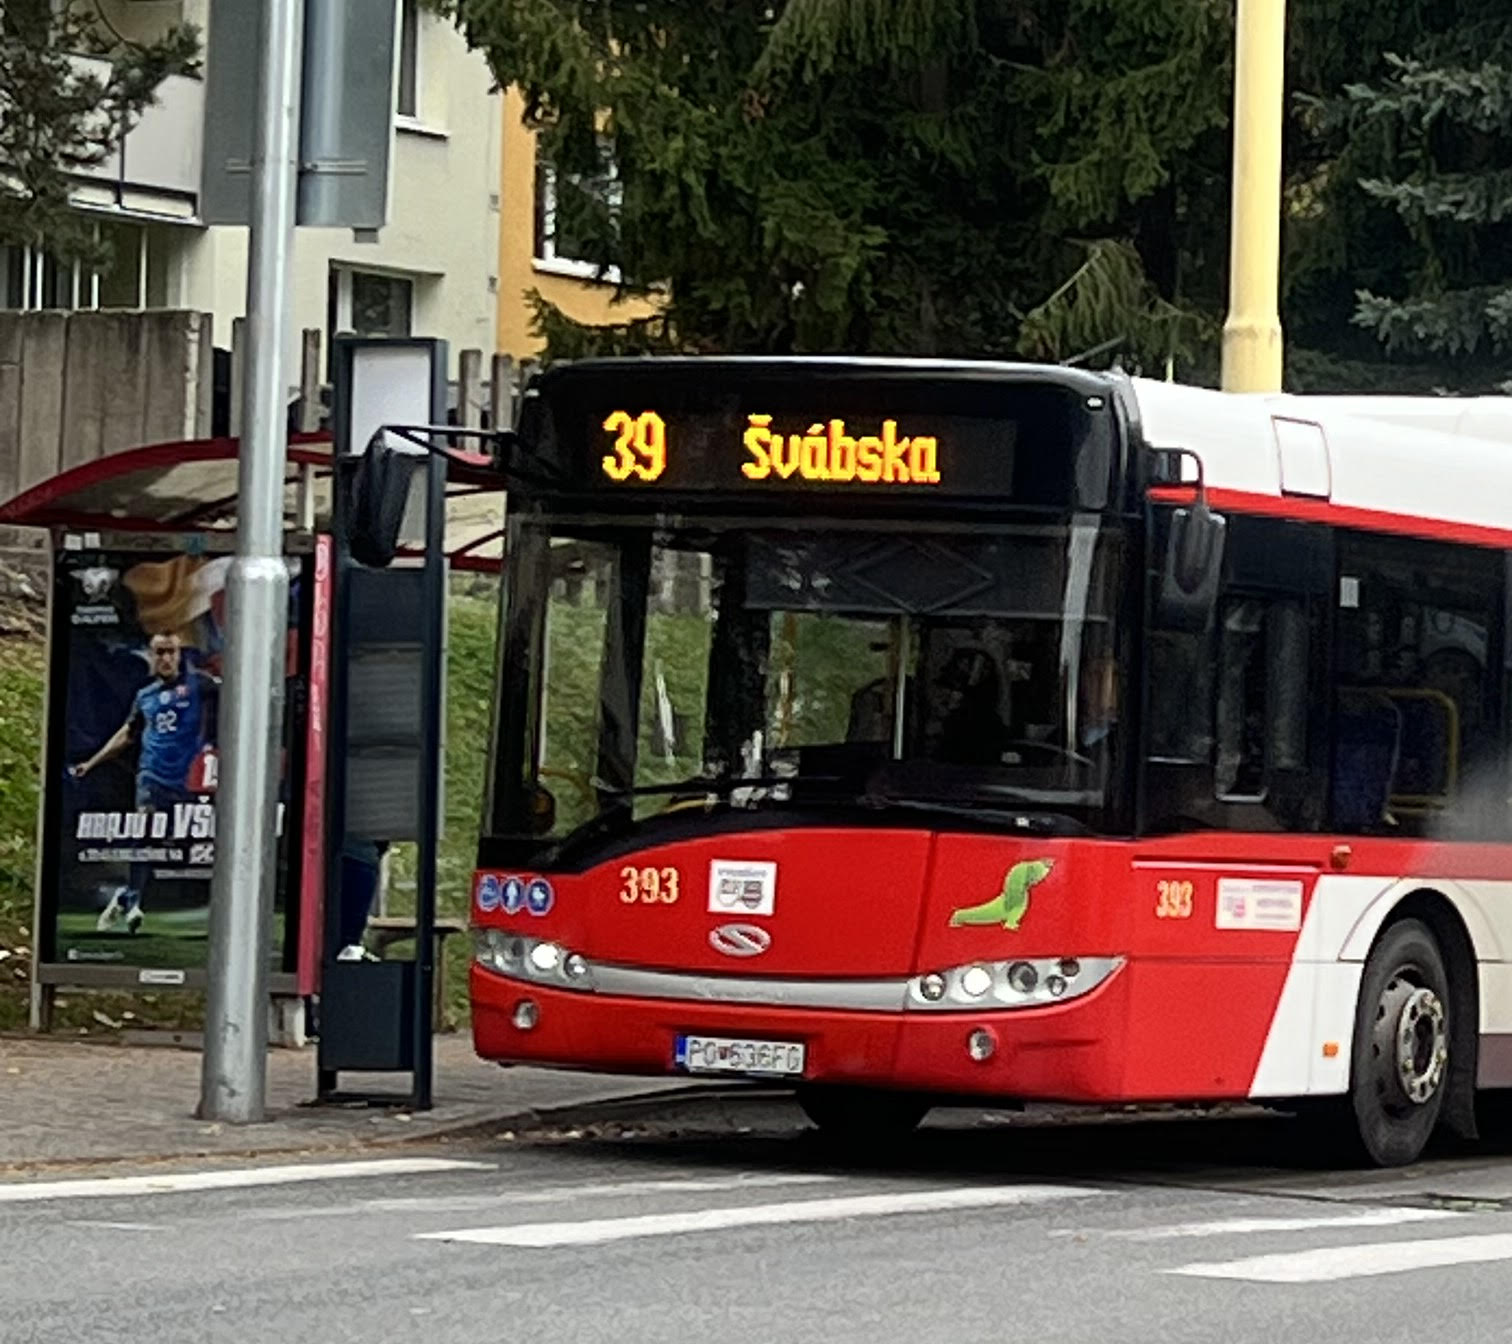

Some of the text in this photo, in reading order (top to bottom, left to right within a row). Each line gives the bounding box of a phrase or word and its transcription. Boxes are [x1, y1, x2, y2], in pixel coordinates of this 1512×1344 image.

[602, 411, 942, 483] 39 Švábska
[620, 867, 679, 904] 393
[1156, 880, 1193, 918] 393
